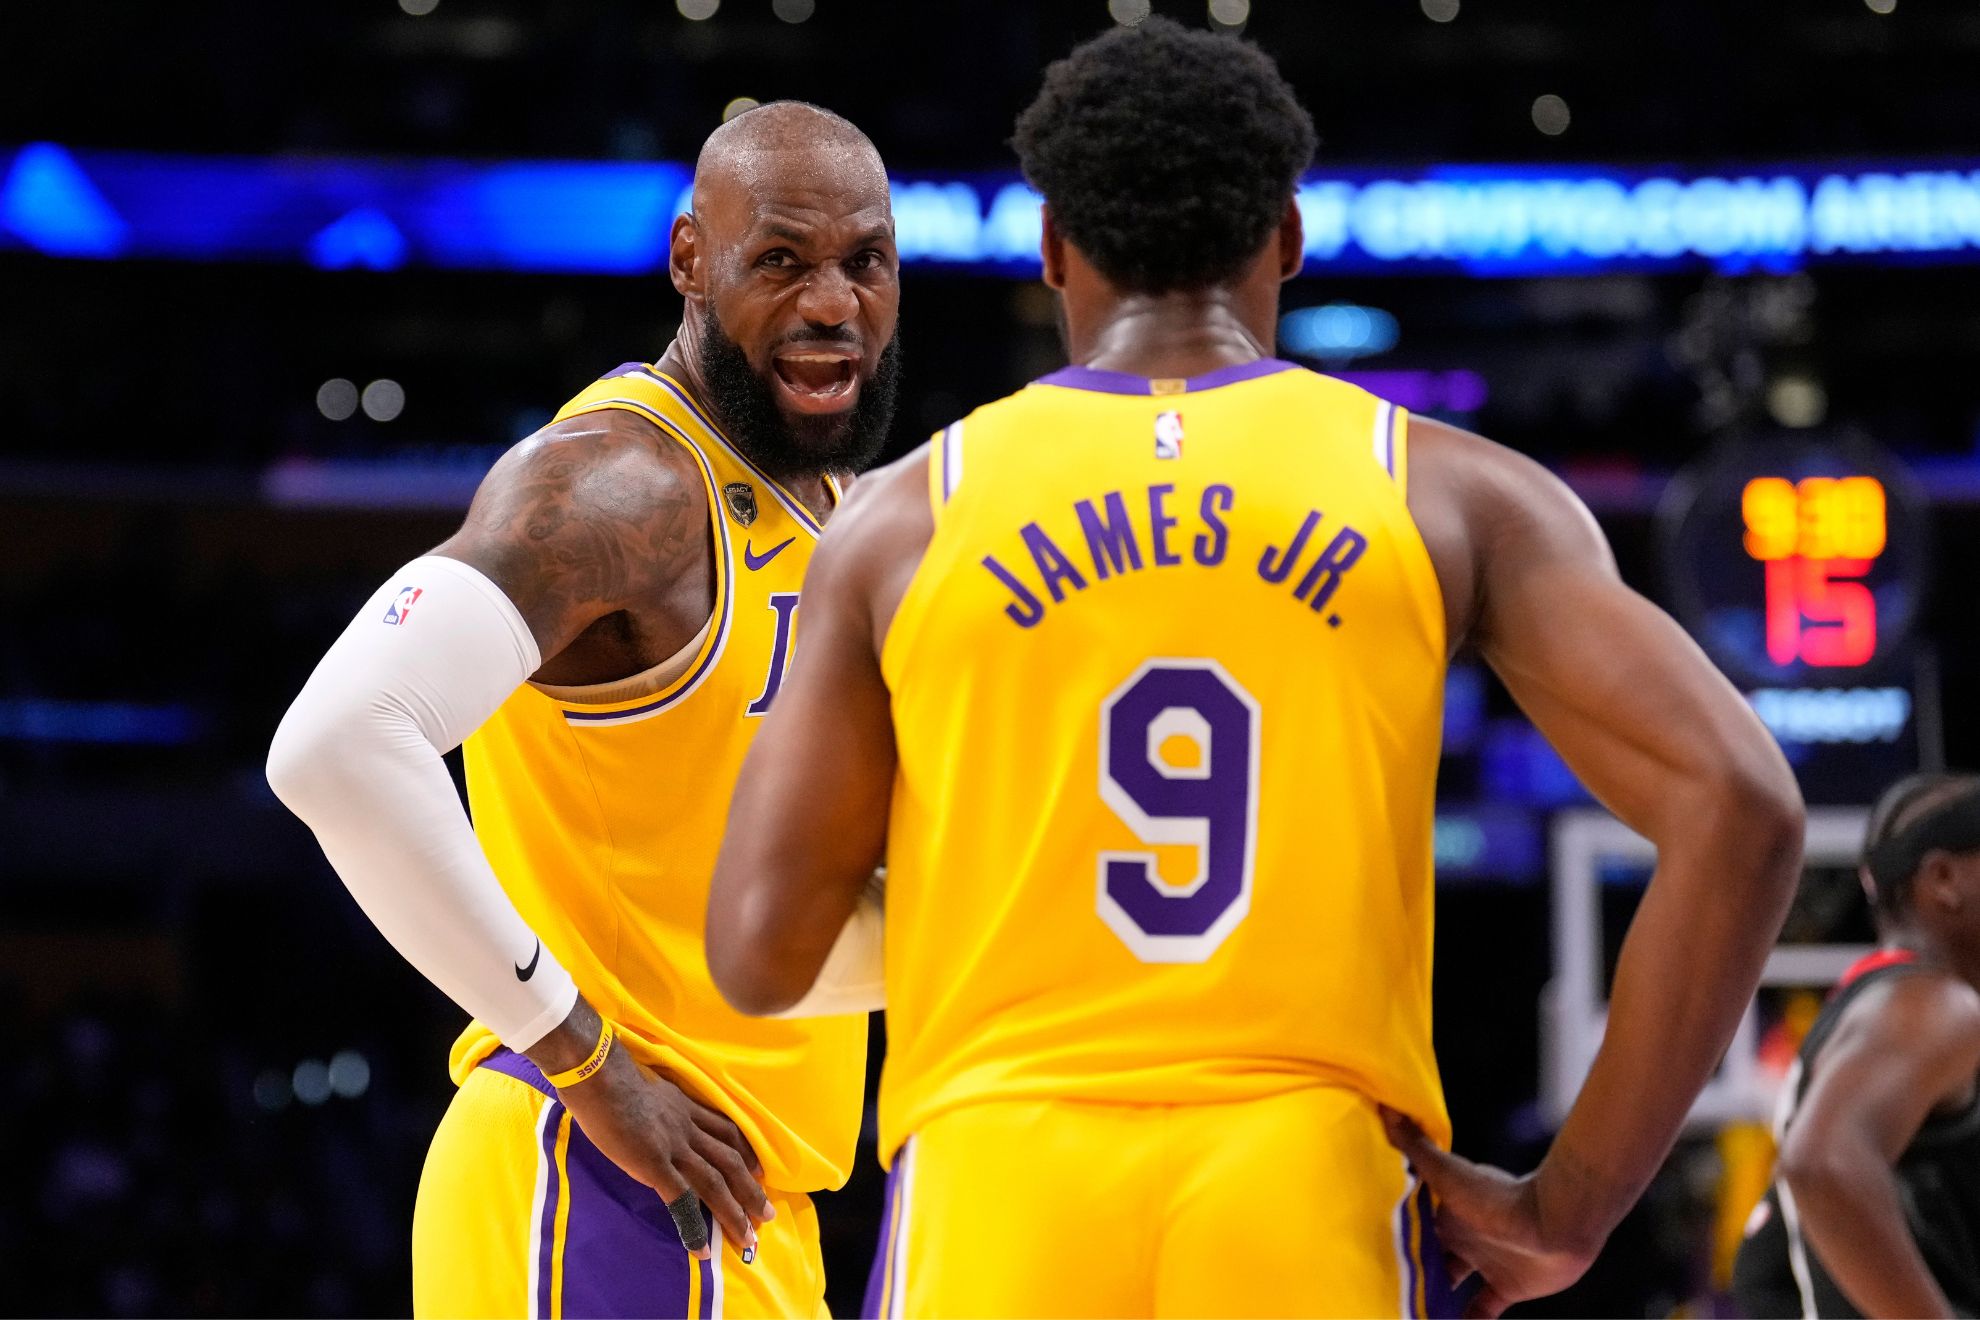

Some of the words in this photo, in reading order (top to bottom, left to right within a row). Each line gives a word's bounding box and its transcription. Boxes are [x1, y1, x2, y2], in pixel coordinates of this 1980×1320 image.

[1353, 179, 1801, 259] CRYPTO.COM
[1811, 171, 1980, 254] AREN
[981, 484, 1234, 629] JAMES
[1257, 510, 1368, 629] JR.
[1765, 555, 1877, 667] 15
[1096, 656, 1262, 964] 9
[576, 1038, 610, 1079] PROMISE
